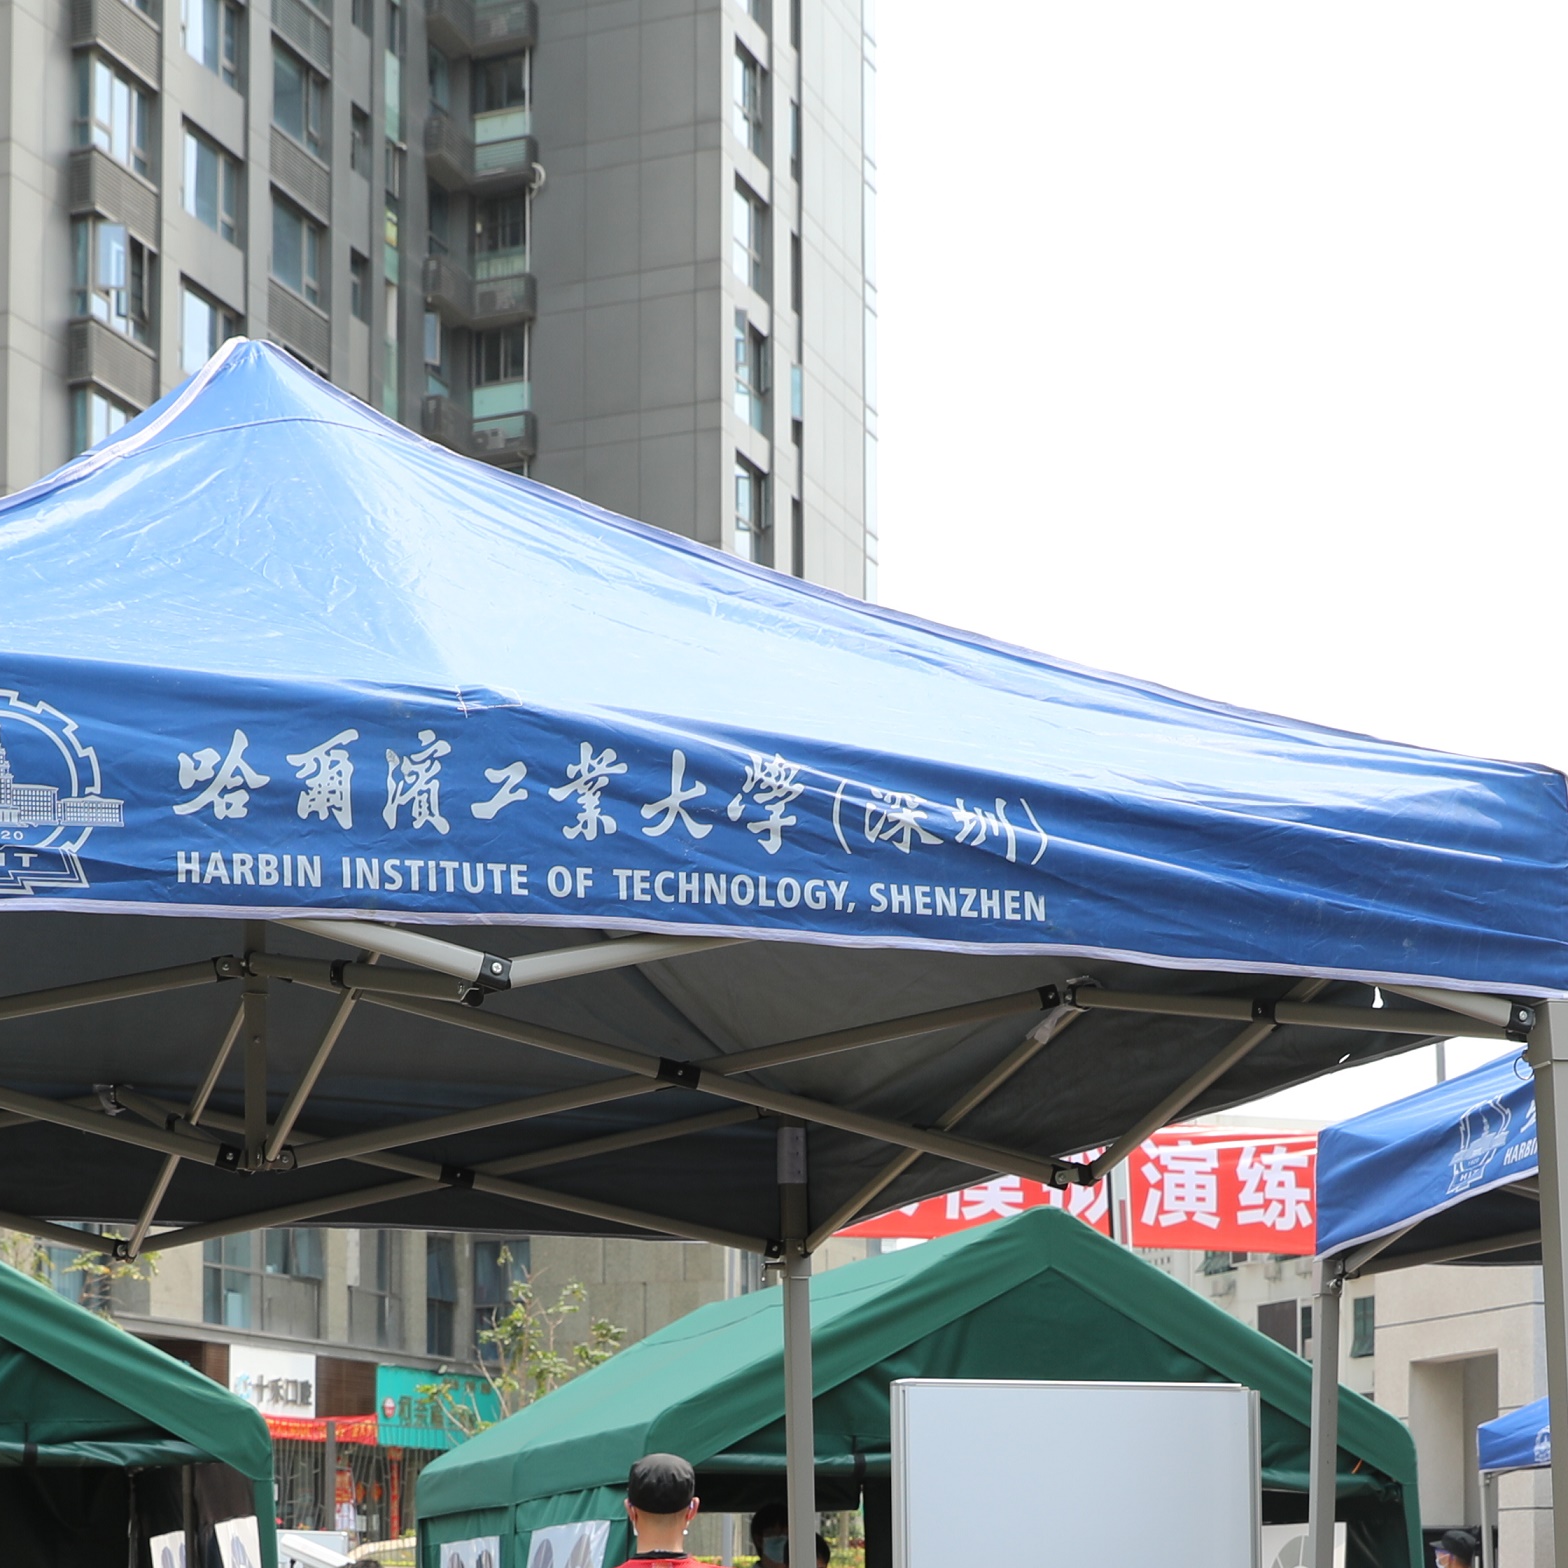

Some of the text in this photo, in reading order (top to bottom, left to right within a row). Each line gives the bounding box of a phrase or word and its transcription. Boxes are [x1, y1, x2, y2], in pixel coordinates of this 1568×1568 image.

[175, 850, 1047, 922] HARBIN INSTITUTE OF TECHNOLOGY, SHENZHEN
